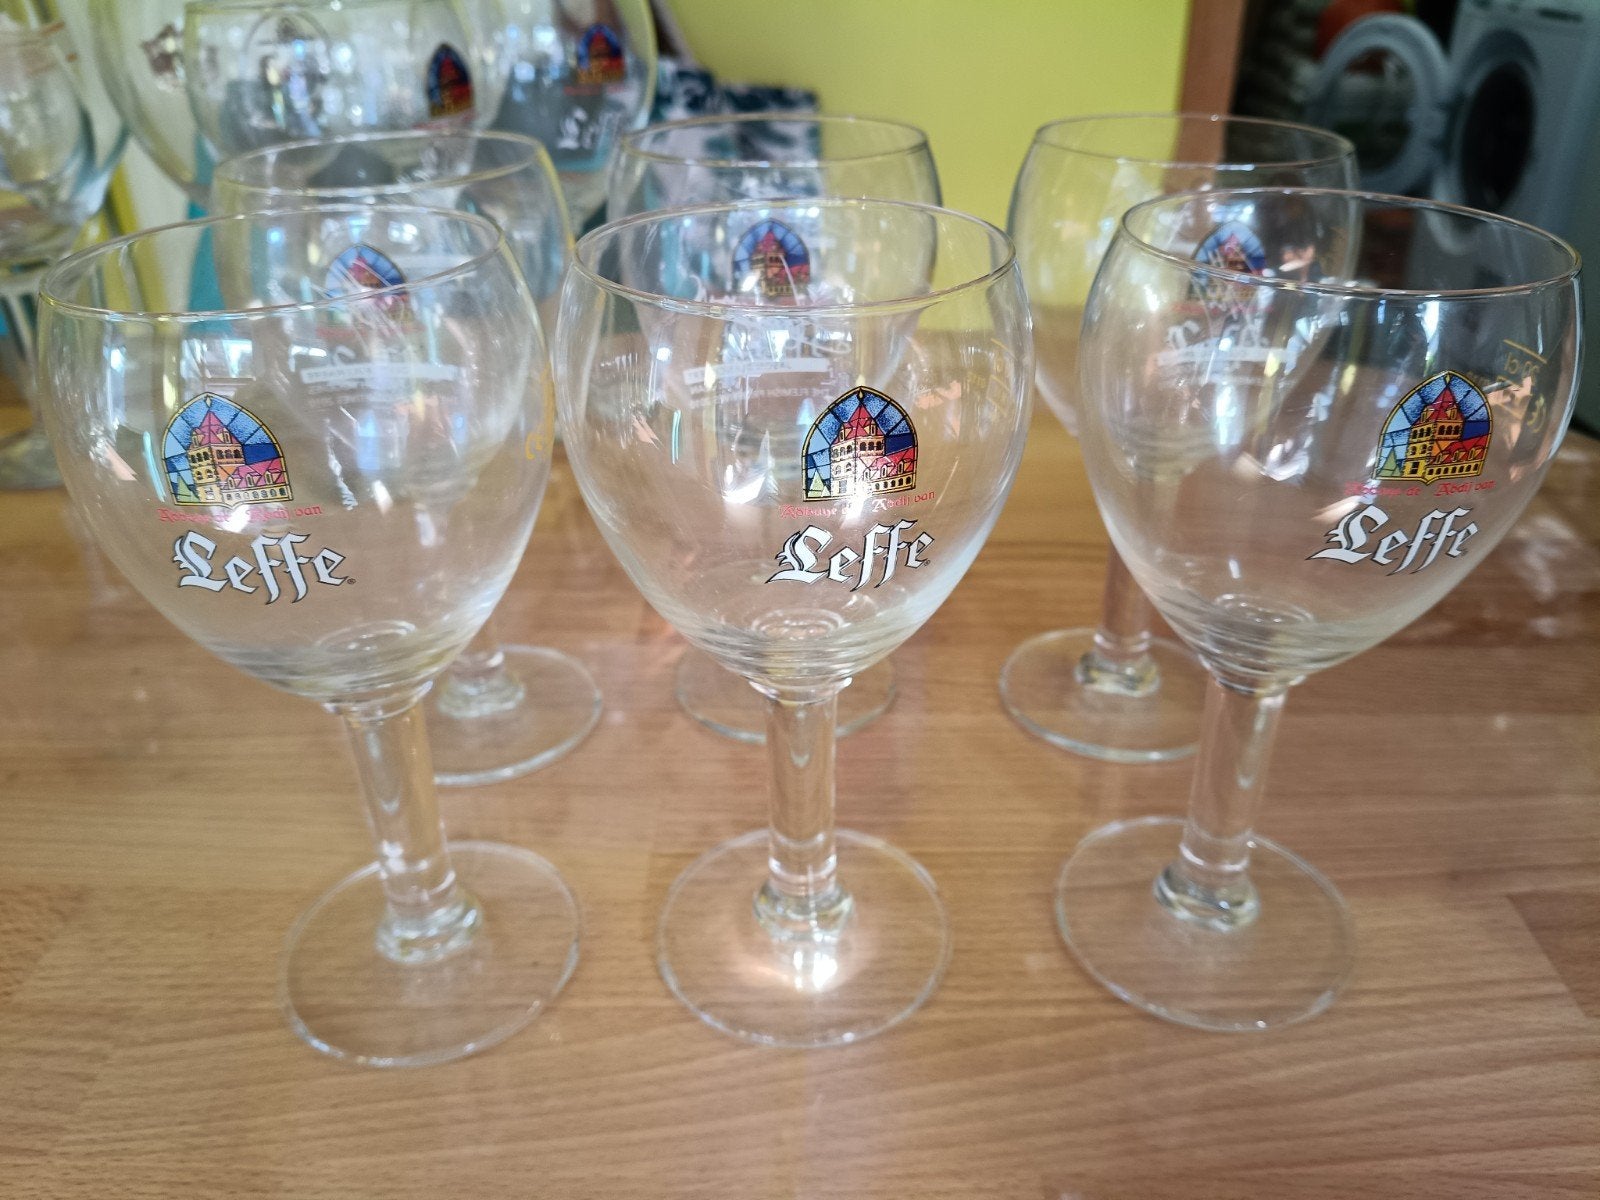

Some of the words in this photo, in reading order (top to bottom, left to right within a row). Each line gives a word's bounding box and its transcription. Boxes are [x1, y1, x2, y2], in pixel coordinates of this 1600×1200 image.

[295, 504, 322, 517] van
[914, 491, 935, 503] van
[172, 530, 348, 605] Leffe
[765, 519, 935, 592] Leffe
[1304, 503, 1479, 577] Leffe
